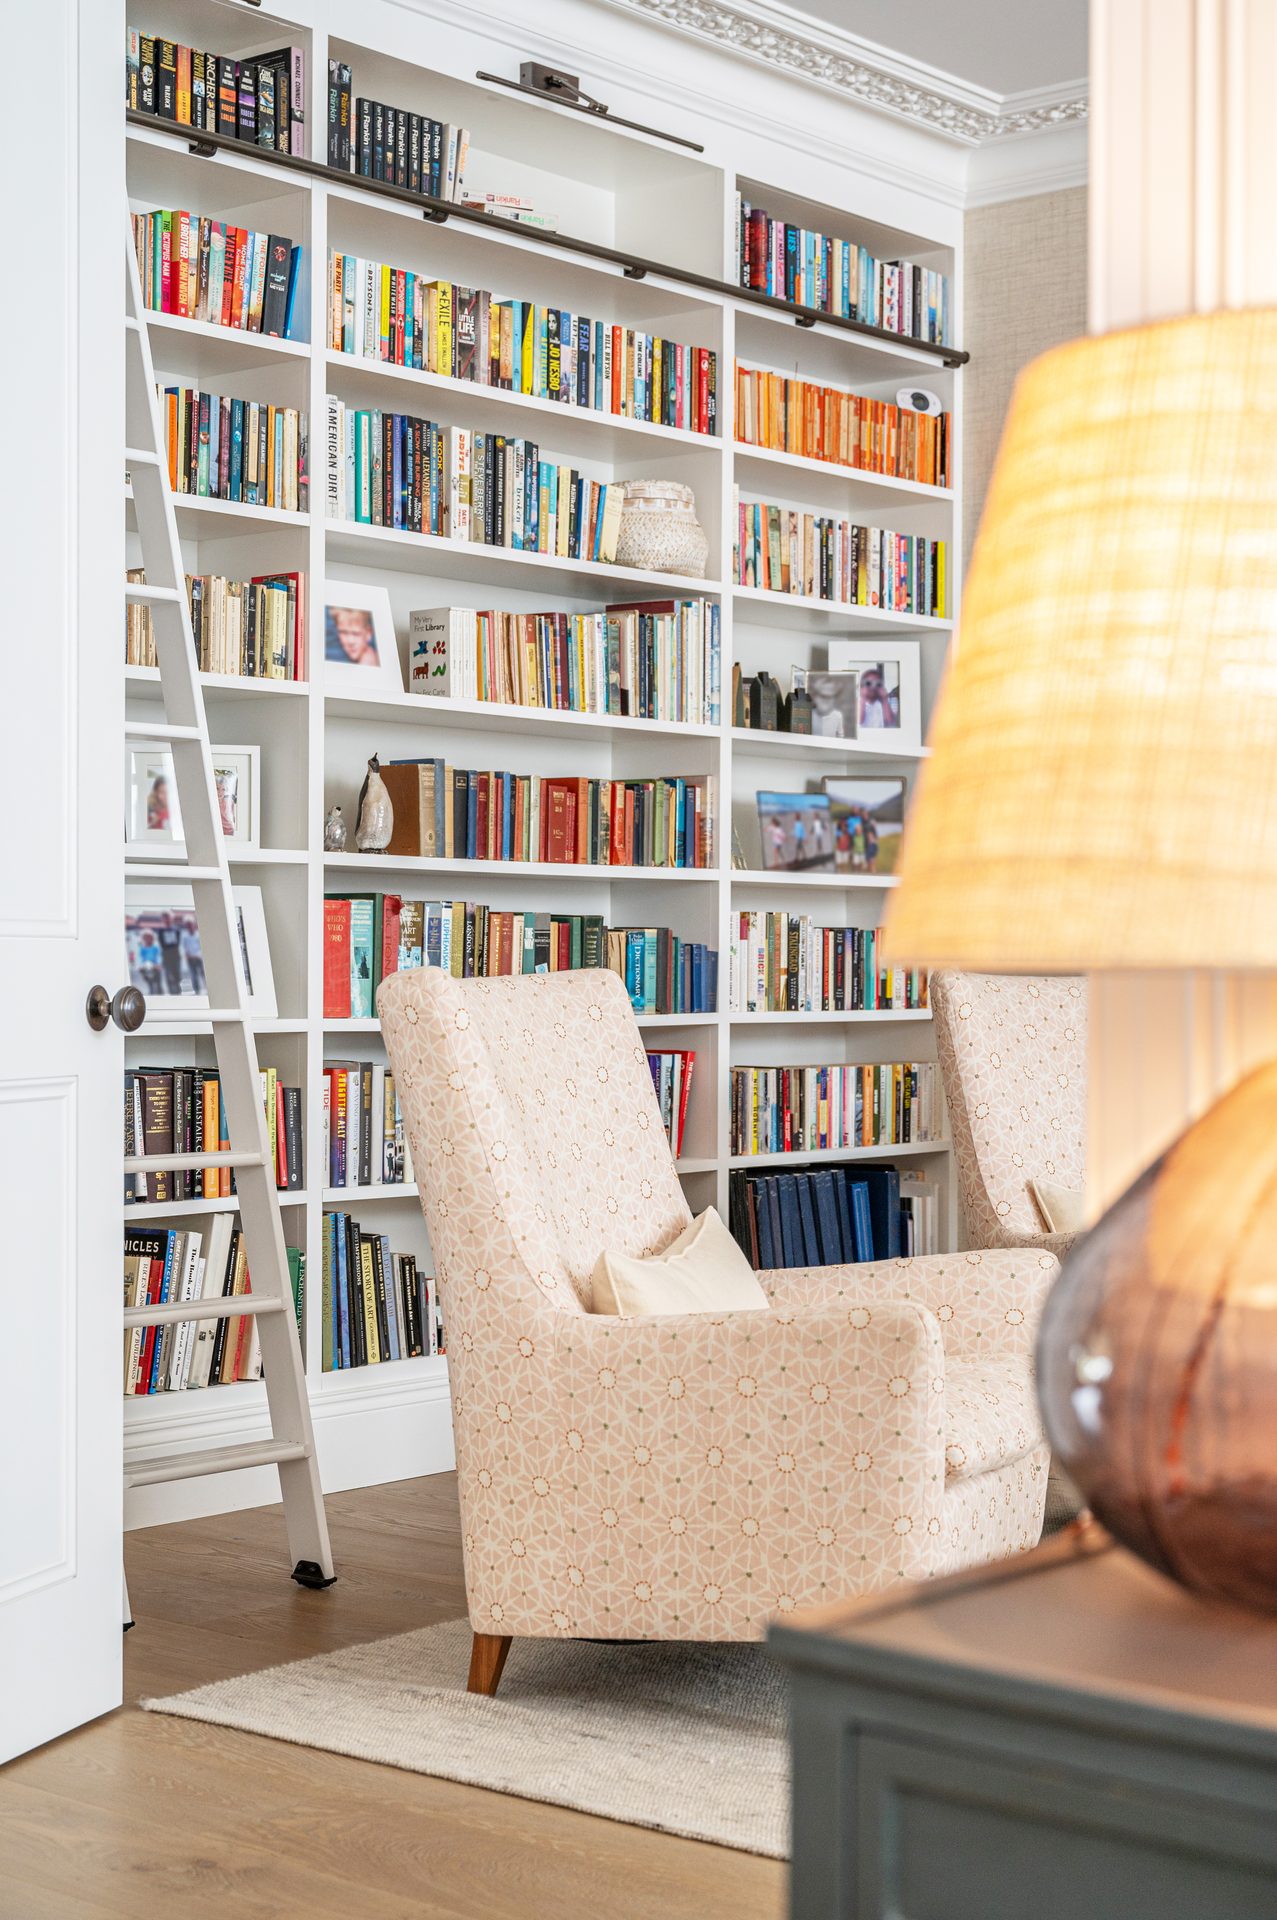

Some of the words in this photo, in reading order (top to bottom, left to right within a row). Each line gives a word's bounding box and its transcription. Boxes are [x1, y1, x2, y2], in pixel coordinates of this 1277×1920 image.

[207, 55, 215, 99] ARCHER
[241, 109, 254, 118] ROBERT
[340, 92, 348, 127] Rankin
[397, 126, 405, 155] Rankin
[180, 224, 189, 258] BROTHER
[179, 259, 188, 280] JOHN
[223, 234, 235, 283] VALENTINE
[258, 256, 266, 278] FOUR
[179, 281, 187, 304] NIVEN
[439, 298, 450, 327] EXILE
[458, 322, 474, 335] LIFE
[580, 324, 589, 351] FEAR
[328, 407, 337, 469] AMERICAN
[328, 473, 337, 501] DIRT
[422, 455, 430, 496] ALEXANDER
[442, 918, 450, 970] EUPHEMISMS
[788, 931, 798, 973] STALINGRAD
[338, 1073, 346, 1117] FORGOTTEN
[337, 1120, 346, 1139] ALLY
[124, 1240, 158, 1253] NICLES
[322, 1224, 331, 1243] THE
[362, 1246, 370, 1264] THE
[170, 1262, 179, 1297] SPORTING
[188, 1264, 196, 1285] Book
[384, 1259, 392, 1287] DECO
[187, 1287, 193, 1295] of
[297, 1269, 305, 1316] ENCHANTED
[366, 1292, 373, 1302] OF
[385, 1288, 394, 1318] BRITAIN
[366, 1303, 374, 1321] ART
